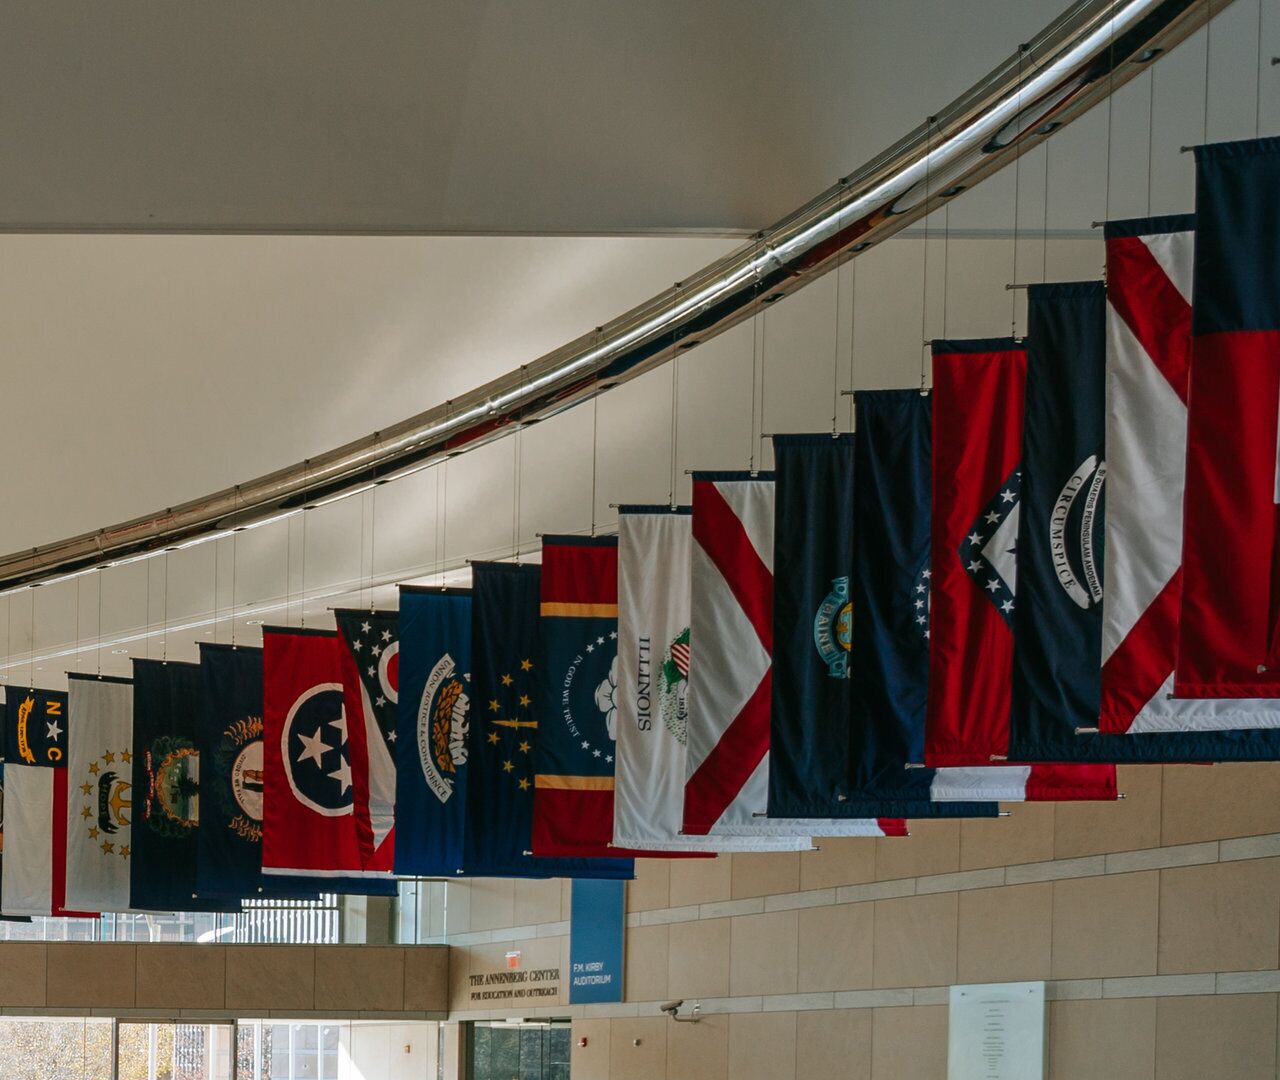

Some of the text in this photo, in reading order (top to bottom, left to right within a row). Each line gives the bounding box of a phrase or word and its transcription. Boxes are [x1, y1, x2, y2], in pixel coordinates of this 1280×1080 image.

[1051, 475, 1082, 590] CIRCUMSPICE
[818, 603, 836, 654] MAINE
[562, 655, 583, 737] IN GOD WE TRUST
[636, 636, 652, 732] ILLINOIS
[46, 701, 62, 715] N
[47, 747, 62, 761] C
[419, 738, 448, 798] CONFIDENCE
[99, 784, 110, 814] HOPE
[469, 968, 560, 987] THE ANNENBERG CENTER
[585, 961, 604, 972] KIRBY
[573, 974, 612, 986] AUDITORIUM
[471, 986, 558, 1001] FOR EDUCATION AND OUTREACH
